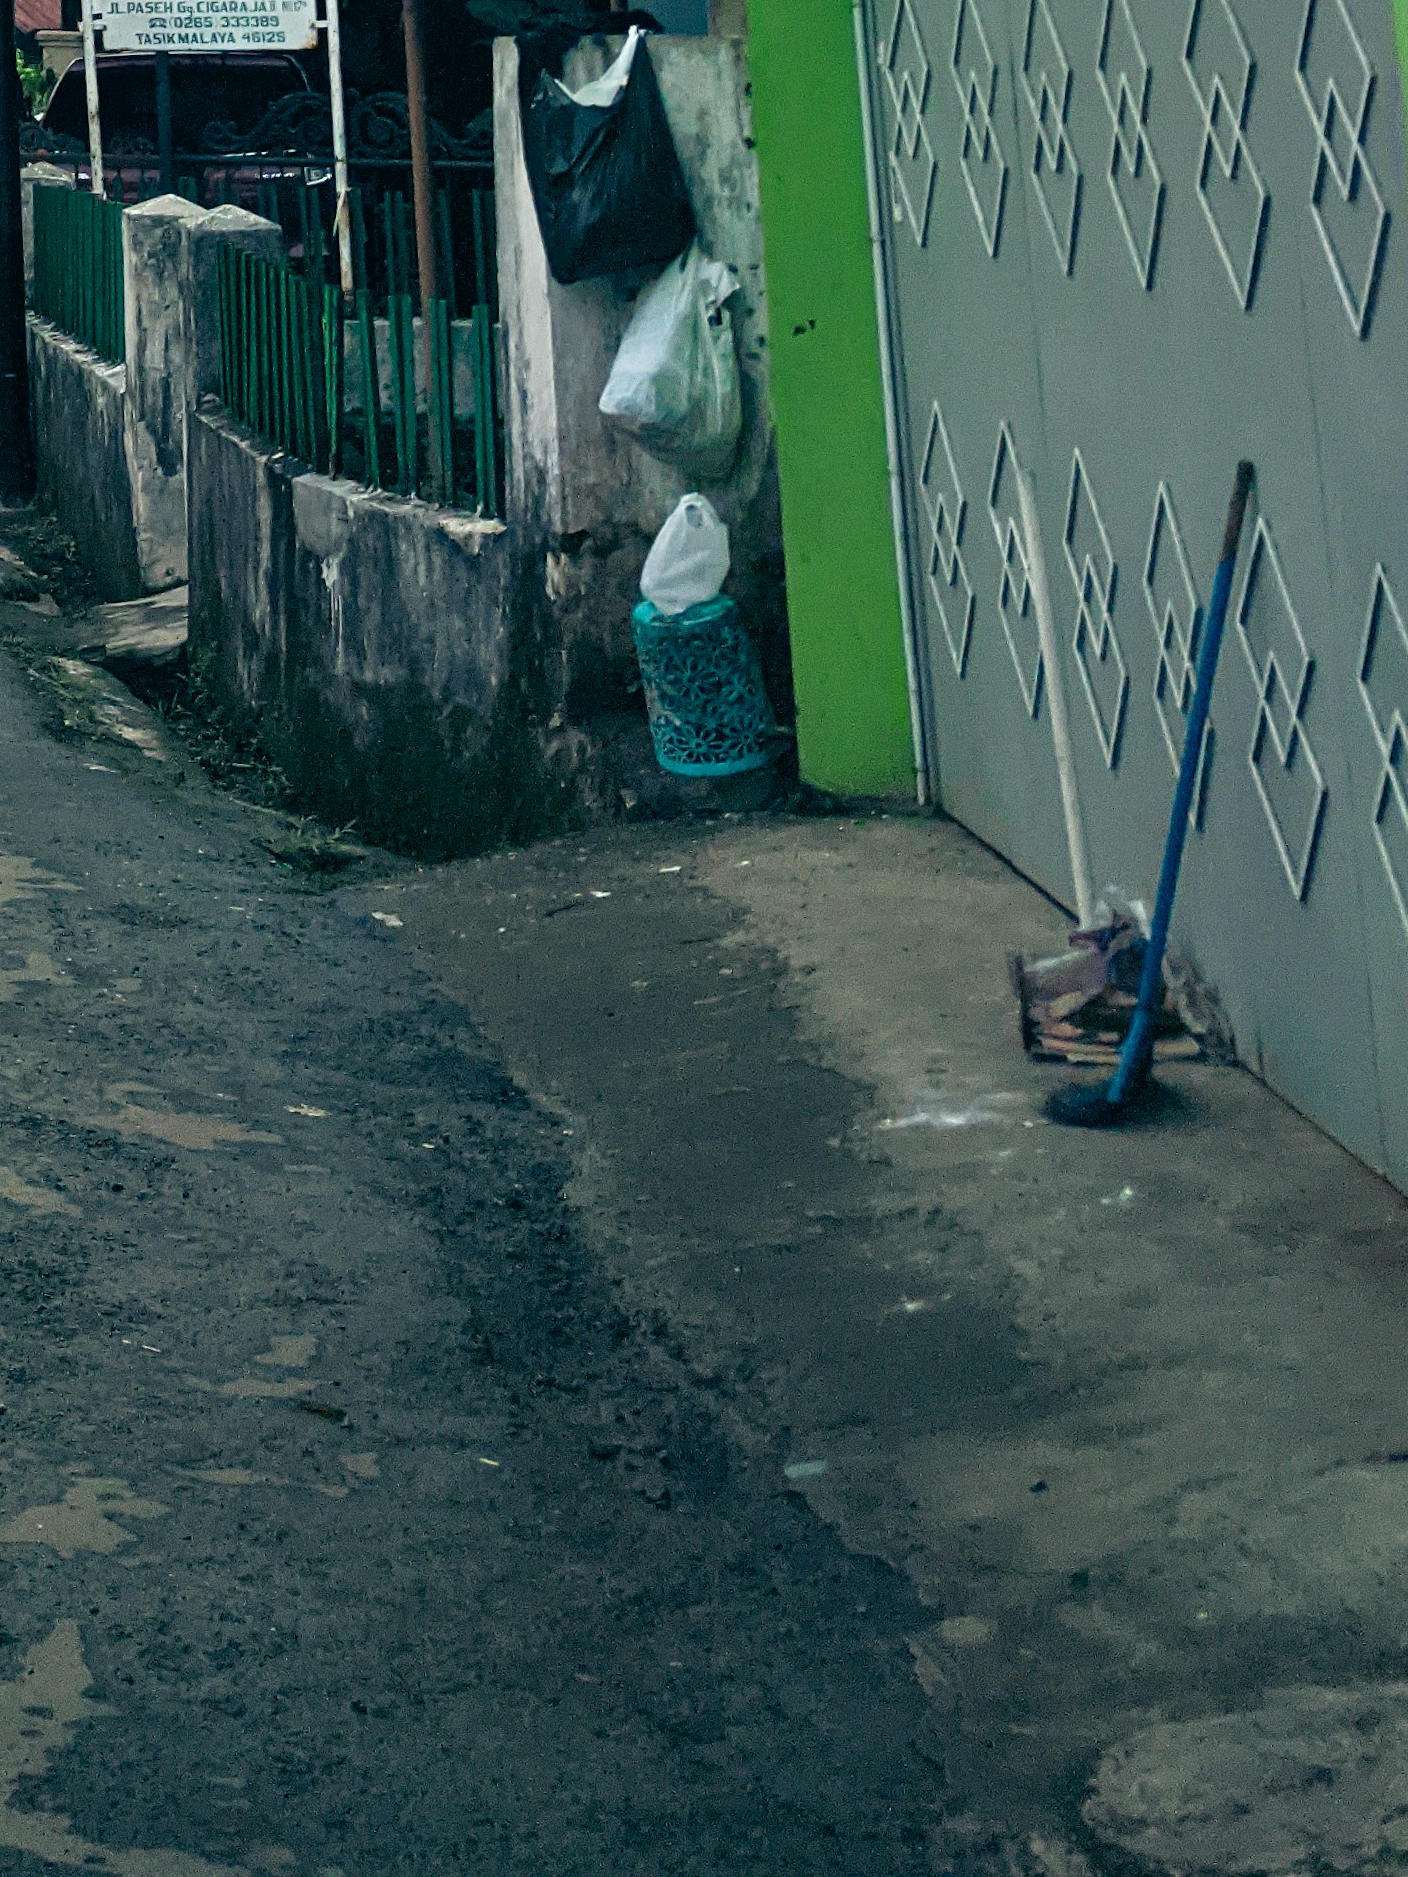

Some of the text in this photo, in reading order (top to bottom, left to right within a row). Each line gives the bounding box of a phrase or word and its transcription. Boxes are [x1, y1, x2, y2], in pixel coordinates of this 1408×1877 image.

[221, 16, 279, 28] 333389
[136, 31, 286, 45] TASIKMALAYA 46125
